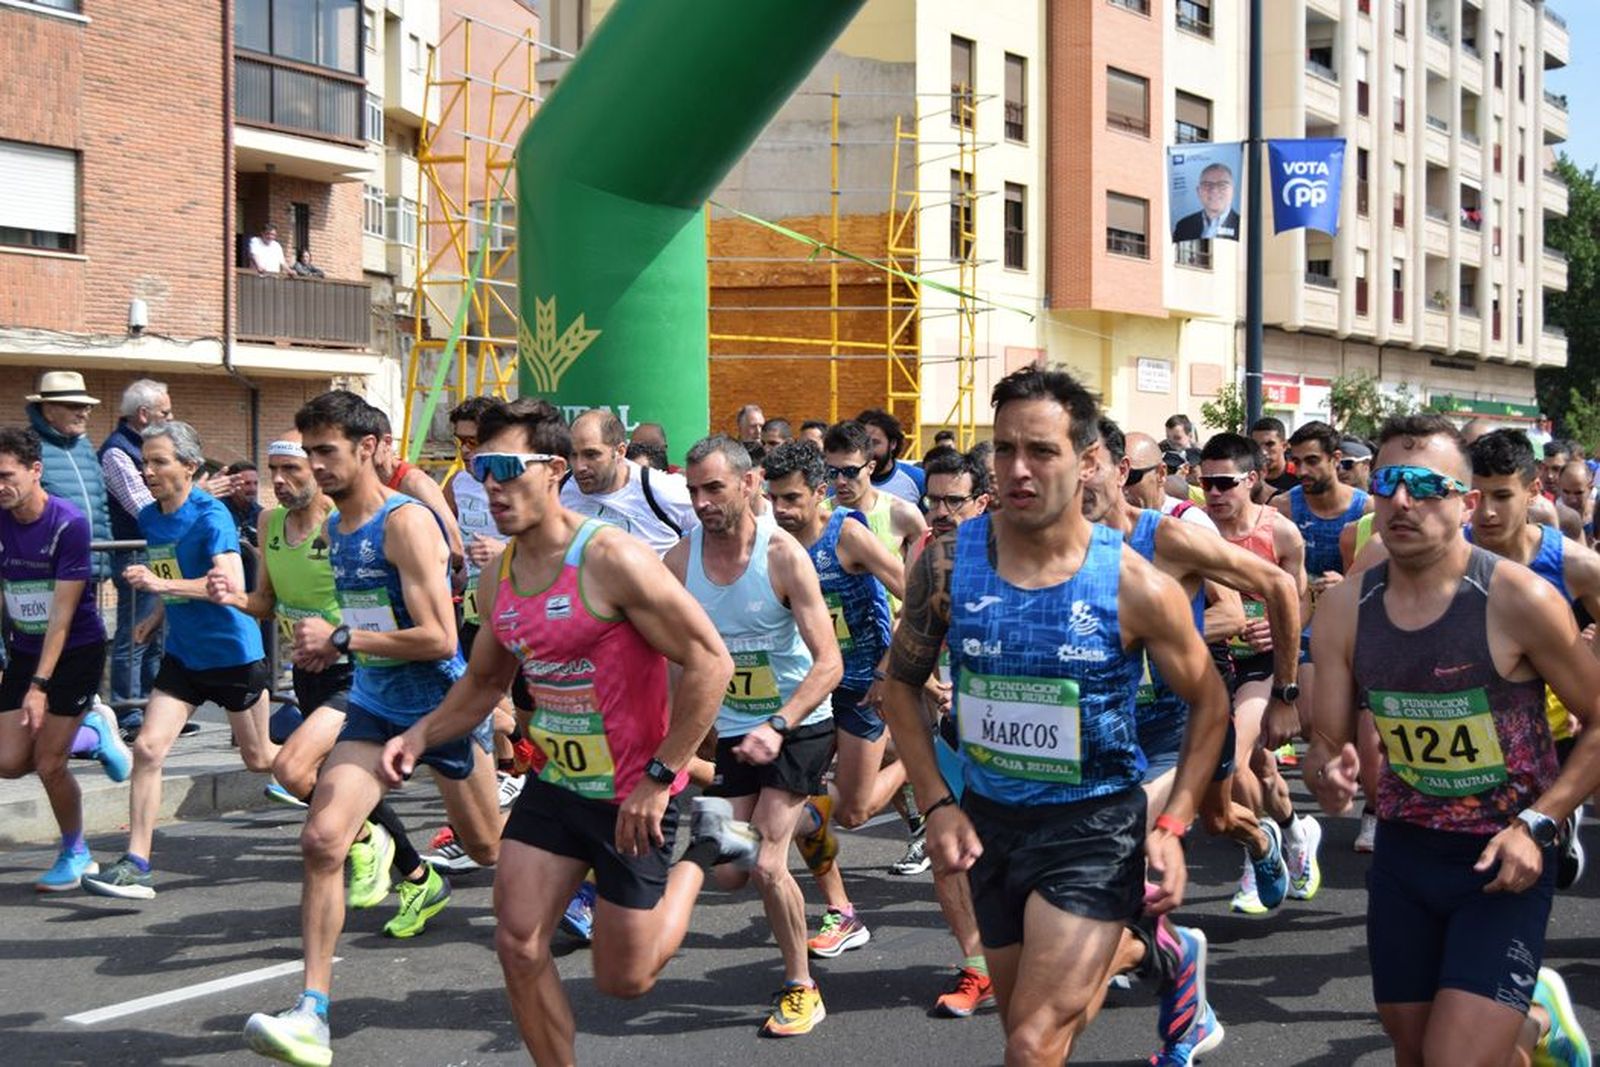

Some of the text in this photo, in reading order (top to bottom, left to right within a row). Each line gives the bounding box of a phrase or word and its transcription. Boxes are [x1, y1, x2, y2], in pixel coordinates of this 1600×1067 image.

[1282, 161, 1330, 176] VOTA
[20, 600, 47, 617] PEÓN
[986, 704, 993, 718] 2
[982, 719, 1059, 750] MARCOS
[1390, 724, 1479, 764] 124
[545, 737, 588, 772] 20
[1027, 761, 1073, 775] RURAL
[1453, 773, 1501, 789] RURAL
